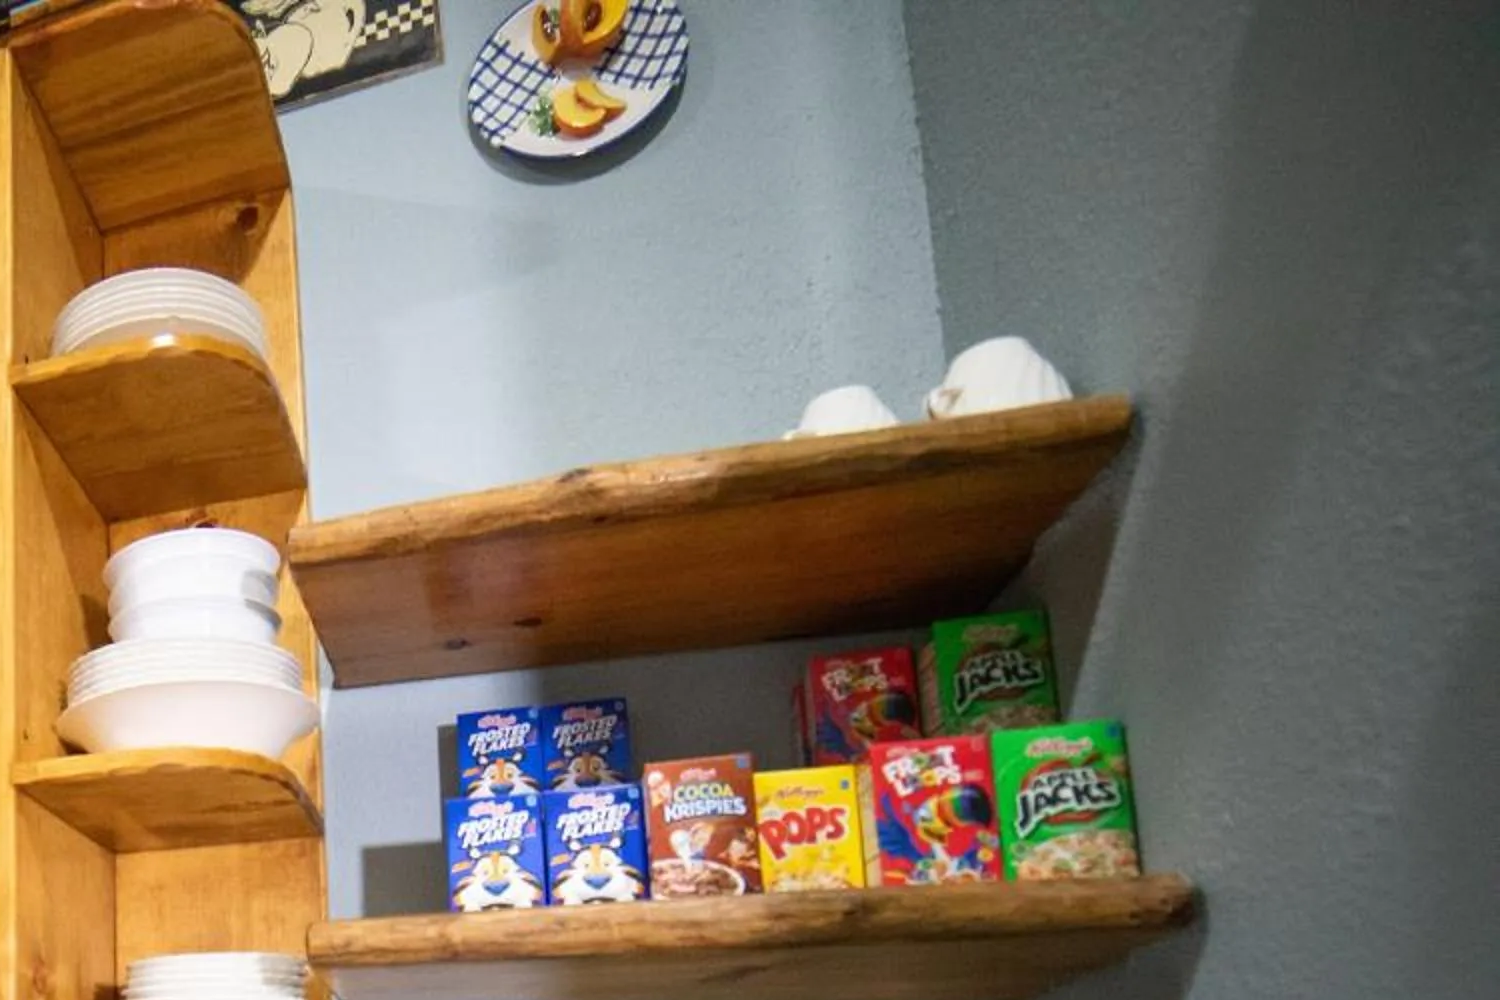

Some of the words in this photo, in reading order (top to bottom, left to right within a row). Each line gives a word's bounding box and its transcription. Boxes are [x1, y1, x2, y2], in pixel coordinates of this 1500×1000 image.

[956, 662, 1042, 712] JACKS
[468, 722, 531, 747] FROSTED
[553, 714, 618, 739] FROSTED
[557, 730, 612, 748] FLAKES
[472, 737, 525, 757] FLAKES
[673, 782, 734, 802] COCOA
[1032, 769, 1097, 790] APPLE
[556, 803, 631, 830] FROSTED
[664, 797, 747, 823] KRISPIES
[1017, 780, 1118, 835] JACKS
[457, 810, 529, 838] FROSTED
[561, 818, 623, 841] FLAKES
[760, 806, 846, 861] POPS
[462, 826, 523, 849] FLAKES
